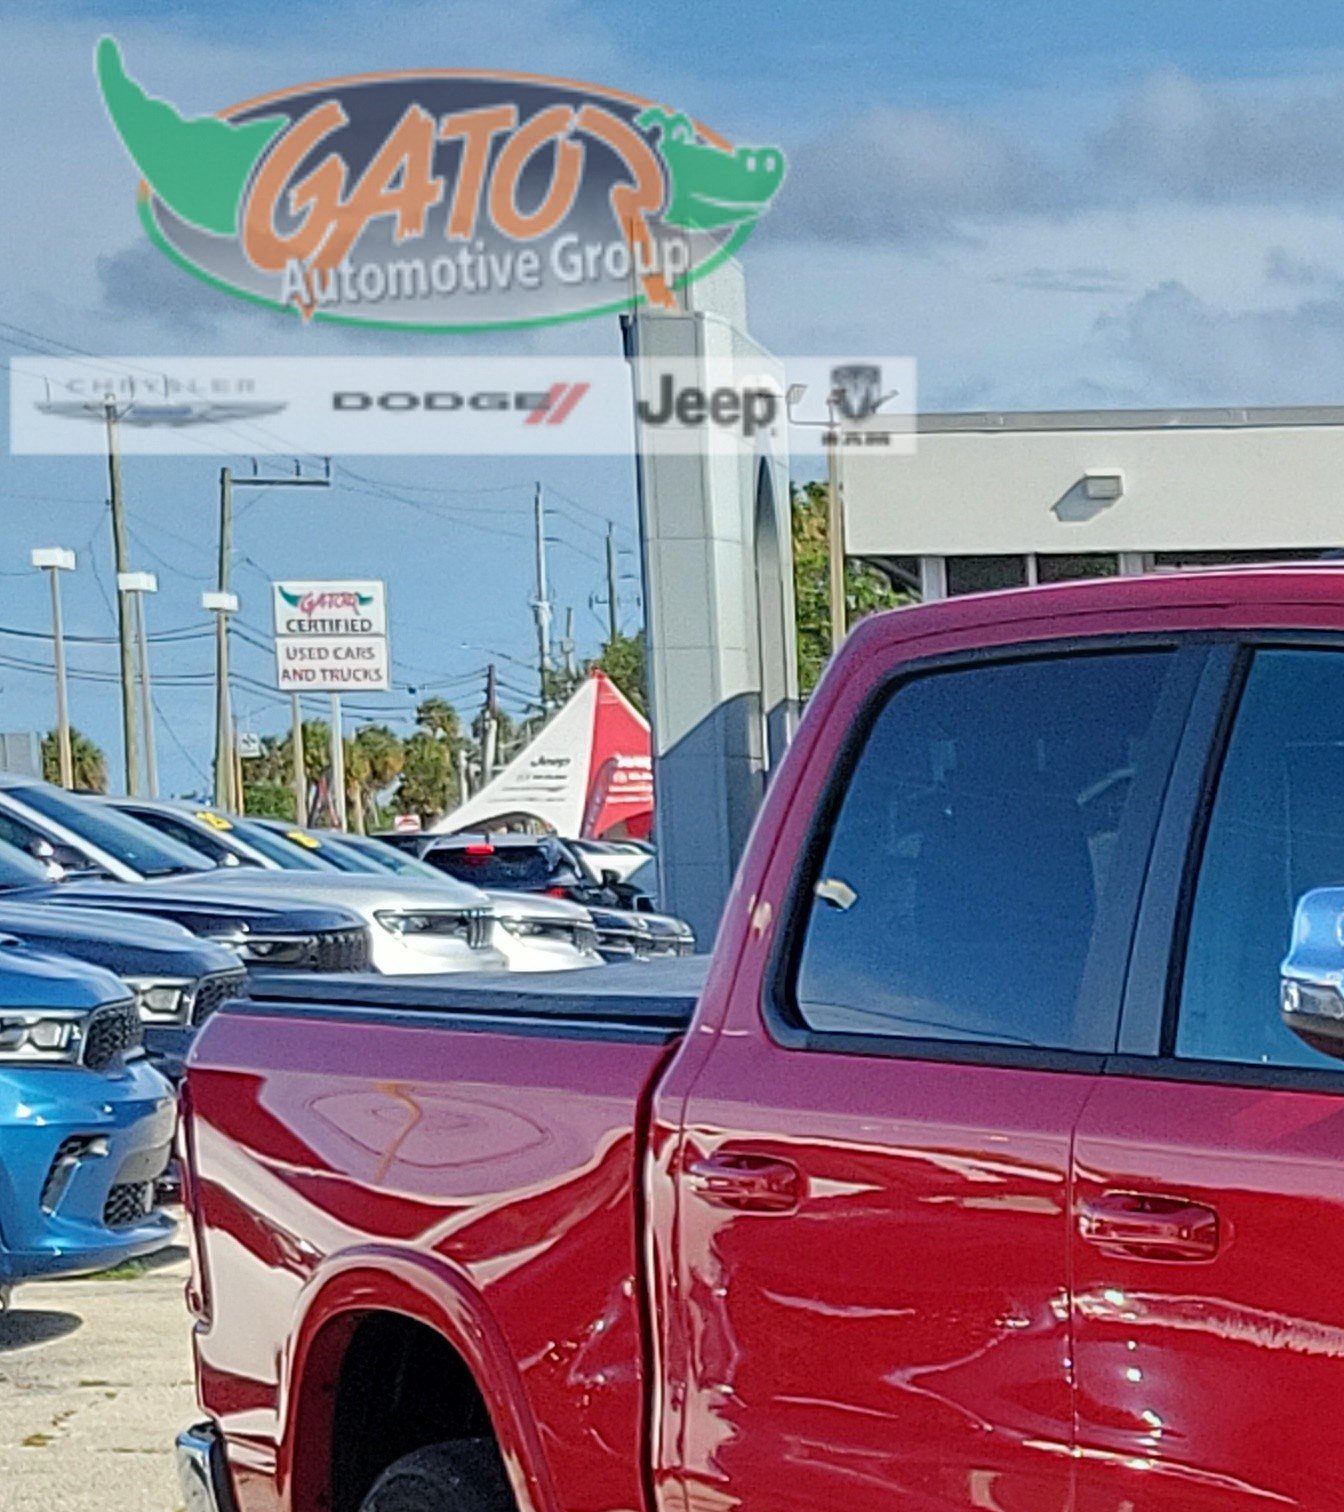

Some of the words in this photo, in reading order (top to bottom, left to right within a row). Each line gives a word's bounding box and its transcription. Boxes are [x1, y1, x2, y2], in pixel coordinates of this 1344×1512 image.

[286, 618, 373, 633] CERTIFIED
[285, 647, 329, 661] USED
[333, 647, 375, 661] CARS
[281, 668, 316, 682] AND
[319, 668, 383, 682] TRUCKS
